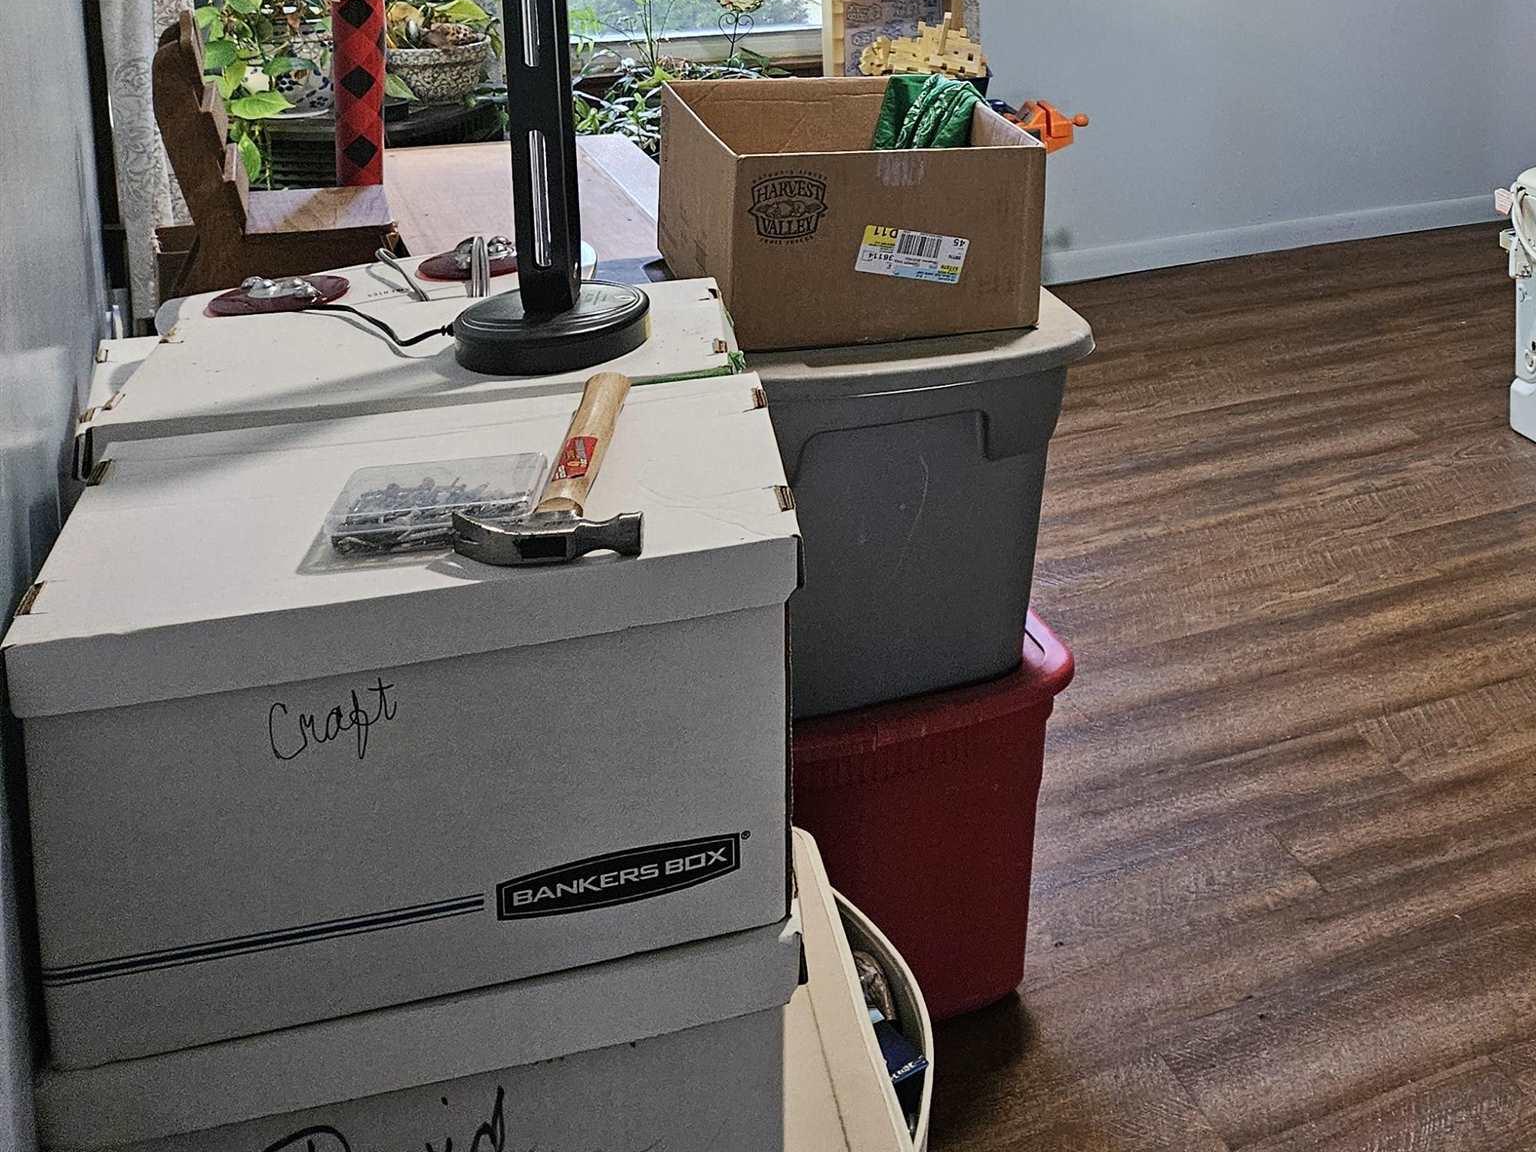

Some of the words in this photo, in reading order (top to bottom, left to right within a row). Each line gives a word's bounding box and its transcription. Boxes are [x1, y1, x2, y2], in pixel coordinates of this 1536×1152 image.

[757, 180, 822, 204] HARVEST
[761, 215, 818, 236] VALLEY
[268, 676, 397, 760] Craft
[512, 863, 659, 906] BANKERS
[665, 846, 729, 876] BOX
